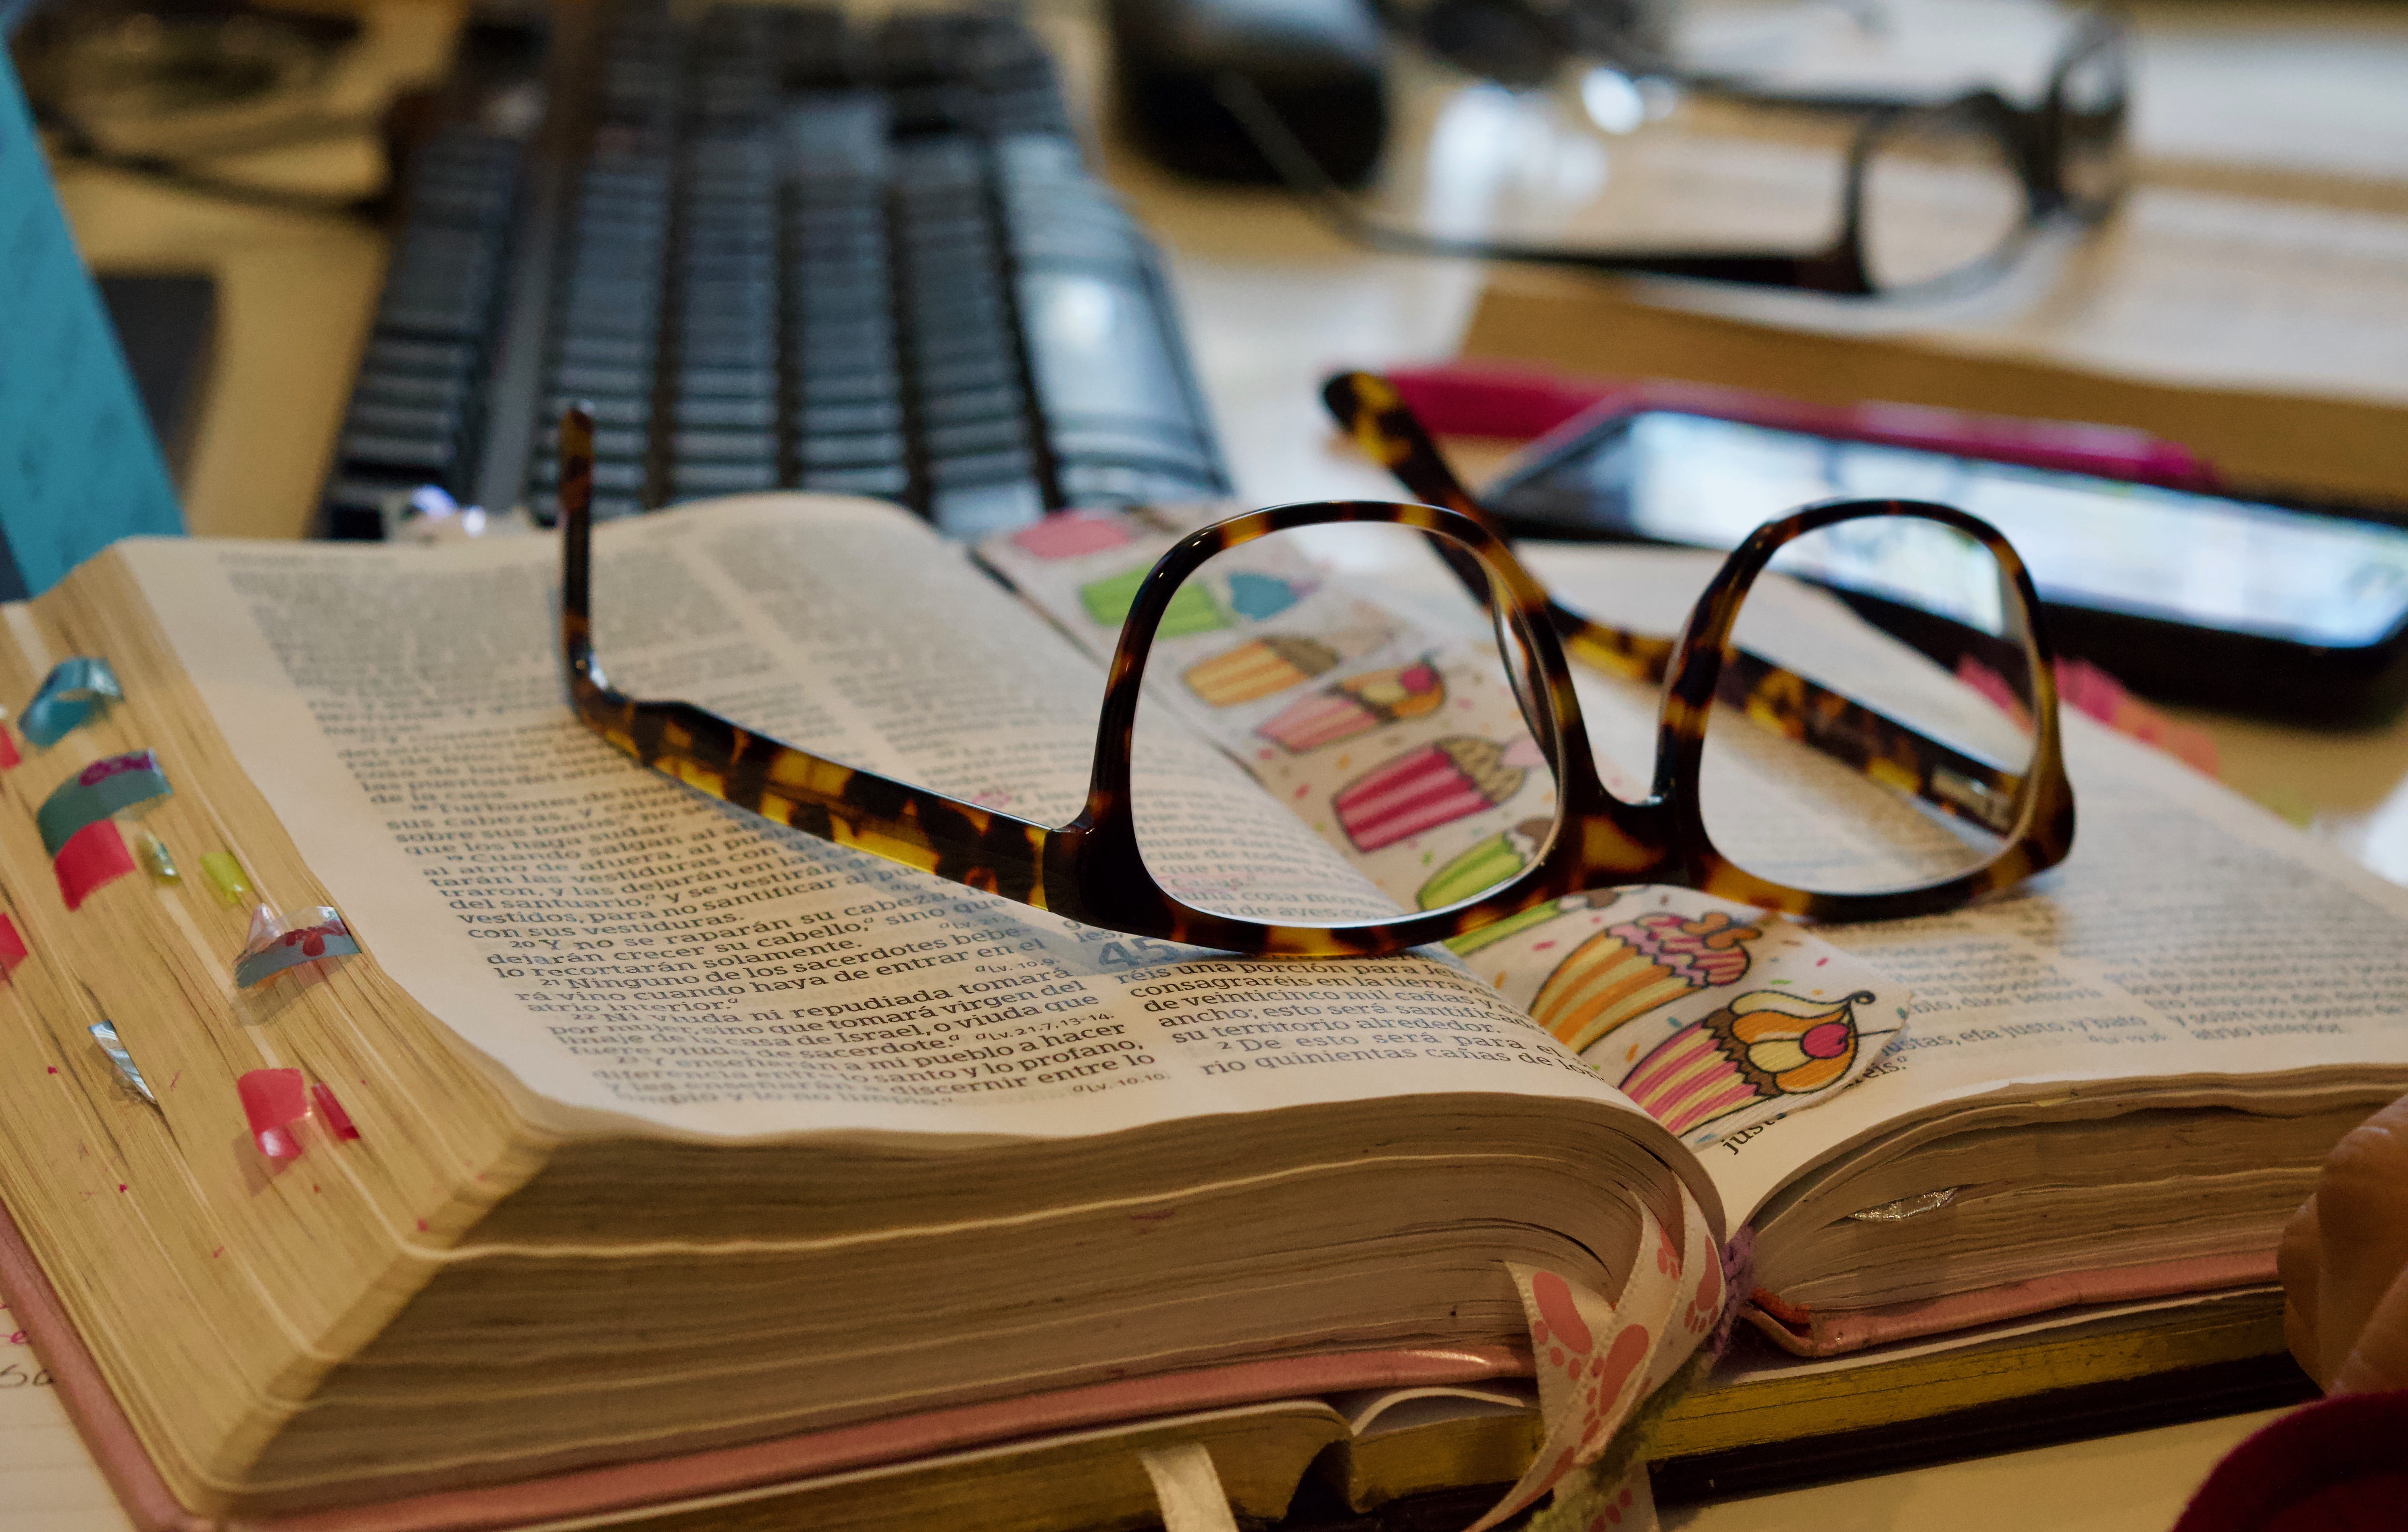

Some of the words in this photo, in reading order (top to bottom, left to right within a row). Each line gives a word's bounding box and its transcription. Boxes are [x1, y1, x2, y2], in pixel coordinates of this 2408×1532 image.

[423, 867, 447, 876] al
[459, 864, 527, 873] atrio
[536, 862, 569, 872] de
[688, 842, 716, 856] al
[588, 835, 683, 856] salgan
[429, 875, 512, 887] tarán
[520, 873, 563, 884] las
[571, 856, 721, 884] vestiduras
[727, 845, 778, 863] con
[548, 887, 563, 897] y
[572, 885, 614, 896] las
[621, 868, 732, 894] dejarán
[739, 861, 774, 874] en
[449, 899, 496, 909] del
[664, 893, 679, 903] y
[688, 886, 717, 897] se
[722, 864, 840, 891] vestirán
[587, 910, 658, 923] para
[662, 905, 697, 917] no
[702, 878, 837, 910] santificar
[468, 928, 522, 938] con
[528, 927, 577, 936] sus
[581, 913, 745, 935] vestiduras.
[487, 953, 606, 964] dejarán
[613, 946, 704, 960] crecer
[714, 942, 749, 952] su
[885, 908, 945, 925] sino
[953, 899, 1007, 914] que
[539, 939, 561, 950] Y
[573, 939, 614, 950] no
[624, 938, 655, 947] se
[664, 918, 793, 945] raparán
[800, 911, 835, 925] su
[493, 967, 525, 978] lo
[531, 962, 697, 976] recortarán
[702, 940, 862, 968] solamente.
[515, 992, 552, 1001] rá
[555, 992, 626, 1001] vino
[633, 985, 746, 1000] cuando
[748, 976, 829, 993] haya
[834, 970, 870, 982] de
[876, 951, 969, 975] entrar
[977, 945, 1014, 958] en
[1020, 938, 1047, 951] el
[564, 976, 700, 989] Ninguno
[706, 971, 741, 982] de
[743, 966, 788, 978] los
[793, 939, 948, 972] sacerdotes
[949, 927, 1030, 945] bebe-
[1099, 936, 1180, 966] 45
[1115, 968, 1171, 984] réis
[1174, 964, 1234, 974] una
[1236, 963, 1349, 973] porción
[1352, 965, 1419, 974] para
[1130, 976, 1313, 997] consagraréis
[1316, 978, 1352, 986] en
[1351, 976, 1384, 987] la
[1384, 977, 1473, 993] tierra,
[528, 1003, 601, 1012] atrio
[547, 1026, 598, 1035] por
[702, 1026, 764, 1035] sino
[769, 1022, 824, 1034] que
[826, 1006, 939, 1028] tomará
[939, 991, 1038, 1014] virgen
[1041, 980, 1087, 996] del
[601, 1013, 641, 1022] Ni
[648, 1014, 743, 1023] viuda
[749, 1010, 784, 1021] ni
[790, 990, 953, 1018] repudiada
[958, 967, 1073, 994] tomará
[1144, 1000, 1180, 1012] de
[1181, 990, 1340, 1006] veinticinco
[1344, 990, 1392, 1000] mil
[1395, 991, 1474, 1004] cañas
[1475, 998, 1492, 1009] y
[556, 1034, 644, 1044] linaje
[650, 1033, 685, 1042] de
[690, 1035, 720, 1044] la
[797, 1035, 832, 1045] de
[835, 1024, 931, 1043] Israel,
[934, 1023, 951, 1032] o
[954, 1005, 1042, 1028] viuda
[1045, 995, 1099, 1012] que
[1159, 1009, 1258, 1027] ancho;
[1263, 1005, 1322, 1017] esto
[1327, 1003, 1392, 1014] será
[1395, 1006, 1546, 1035] santificado
[1172, 1030, 1209, 1043] su
[1211, 1019, 1350, 1037] territorio
[1356, 1017, 1502, 1033] alrededor.
[756, 1049, 791, 1057] de
[839, 1072, 868, 1082] lo
[873, 1070, 957, 1082] santo
[959, 1066, 978, 1078] y
[982, 1062, 1014, 1074] lo
[1018, 1040, 1143, 1071] profano,
[845, 1062, 862, 1070] a
[867, 1057, 909, 1069] mi
[912, 1046, 1014, 1067] pueblo
[1019, 1042, 1040, 1052] a
[1038, 1024, 1125, 1047] hacer
[1200, 1061, 1246, 1075] rio
[1255, 1049, 1417, 1068] quinientas
[1426, 1048, 1511, 1062] cañas
[1518, 1053, 1554, 1066] de
[1217, 1041, 1232, 1049] 2
[1236, 1039, 1282, 1051] De
[1296, 1036, 1359, 1046] esto
[1372, 1032, 1442, 1043] será
[1451, 1036, 1527, 1049] para
[1536, 1045, 1565, 1058] el
[891, 1076, 1027, 1095] discernir
[1038, 1061, 1119, 1083] entre
[1122, 1054, 1155, 1066] lo
